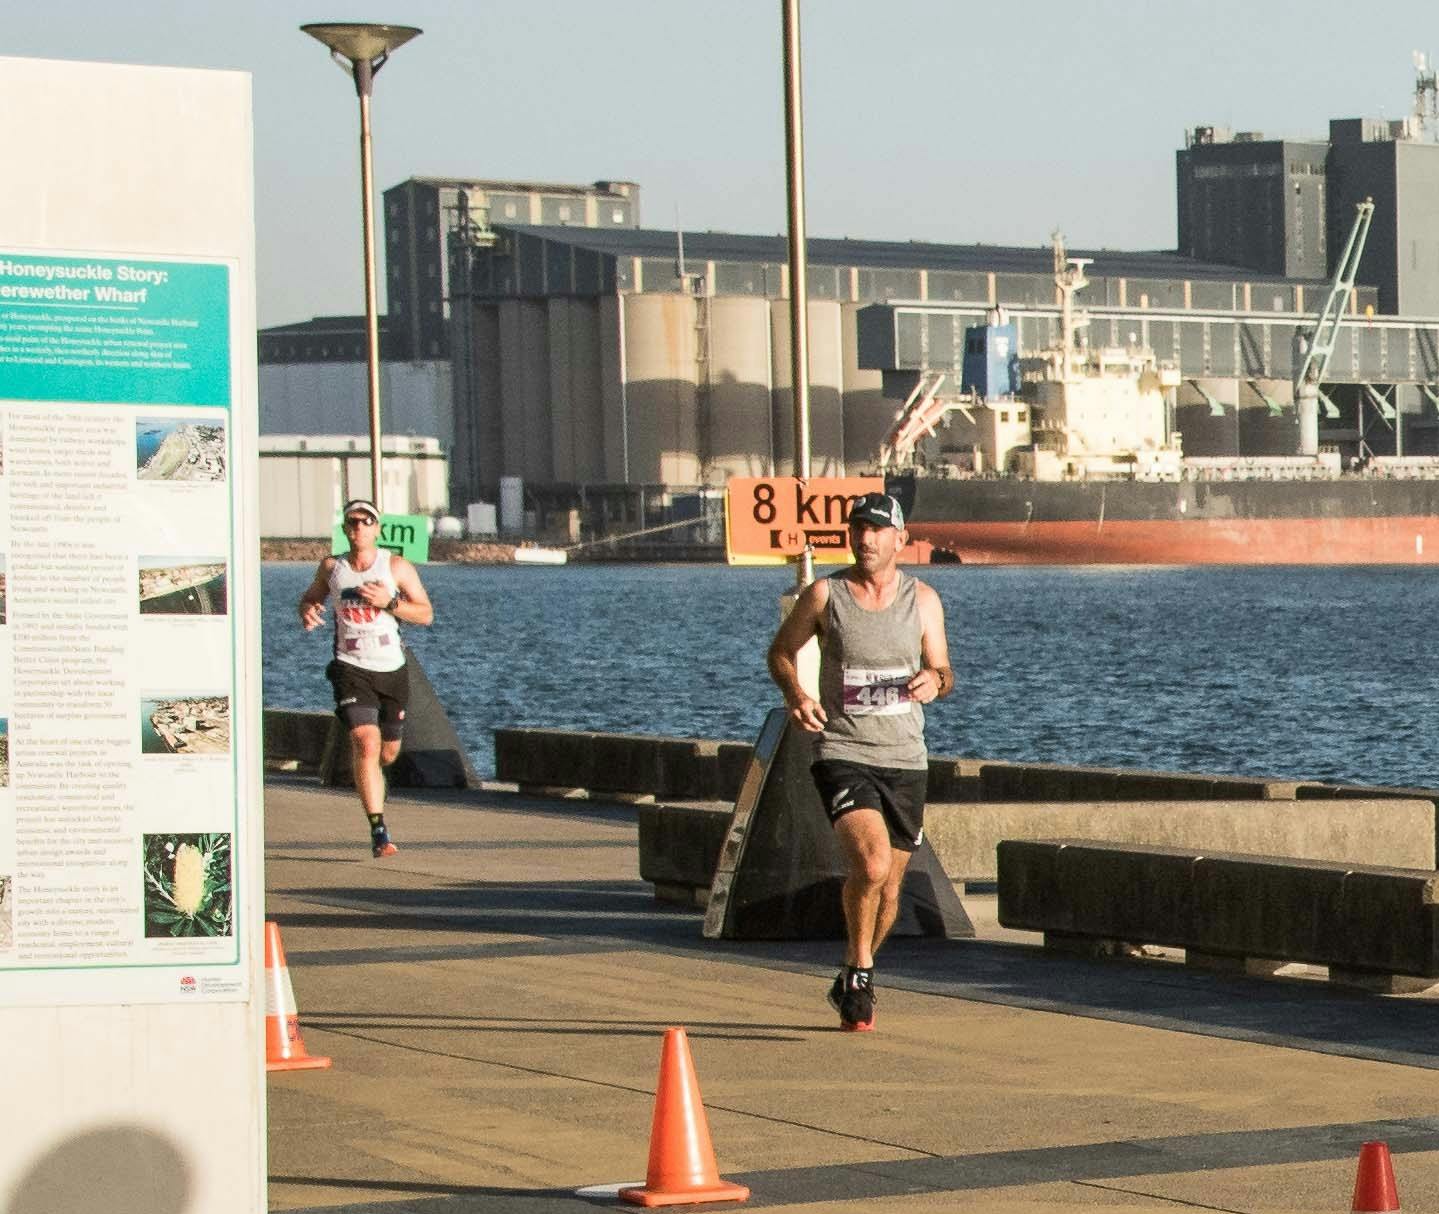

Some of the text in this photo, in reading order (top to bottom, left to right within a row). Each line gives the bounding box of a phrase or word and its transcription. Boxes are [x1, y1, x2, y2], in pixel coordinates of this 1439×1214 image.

[0, 260, 169, 284] Honeysuckle Story:
[1, 284, 147, 303] erewether Wharf
[753, 483, 859, 524] 8 km
[787, 533, 798, 545] H
[808, 534, 841, 545] events
